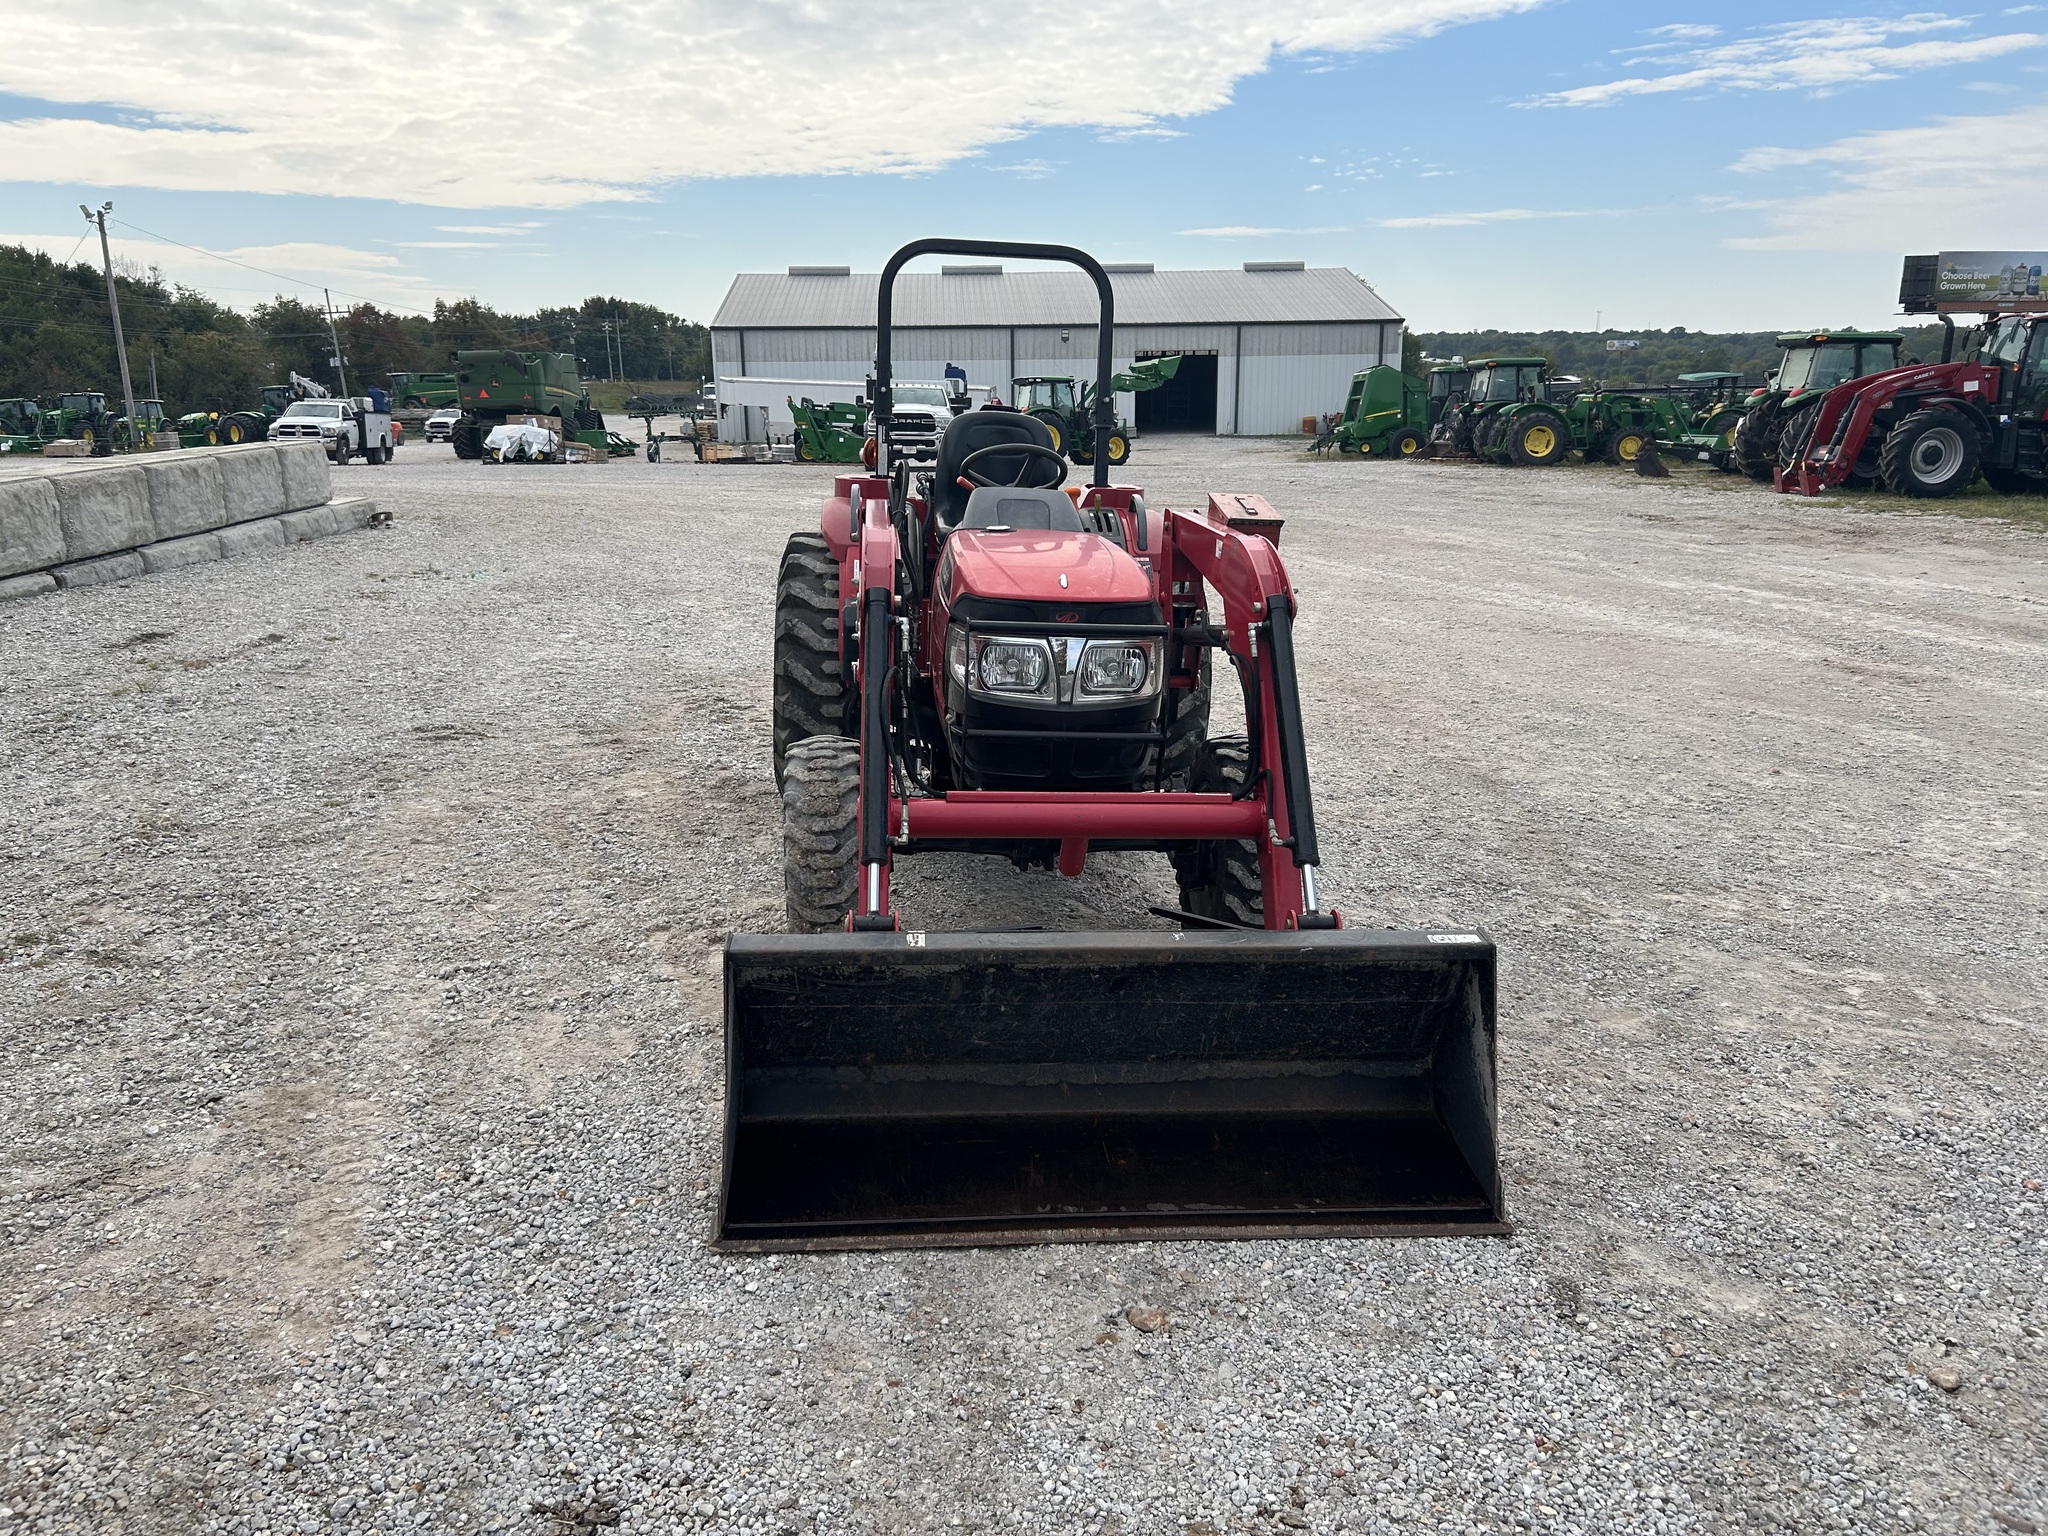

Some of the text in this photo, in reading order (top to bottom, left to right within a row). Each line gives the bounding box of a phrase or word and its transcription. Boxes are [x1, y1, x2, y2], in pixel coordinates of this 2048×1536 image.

[1941, 271, 1972, 280] Choose
[1973, 271, 1991, 280] Beer
[1940, 281, 1986, 290] Grown Here
